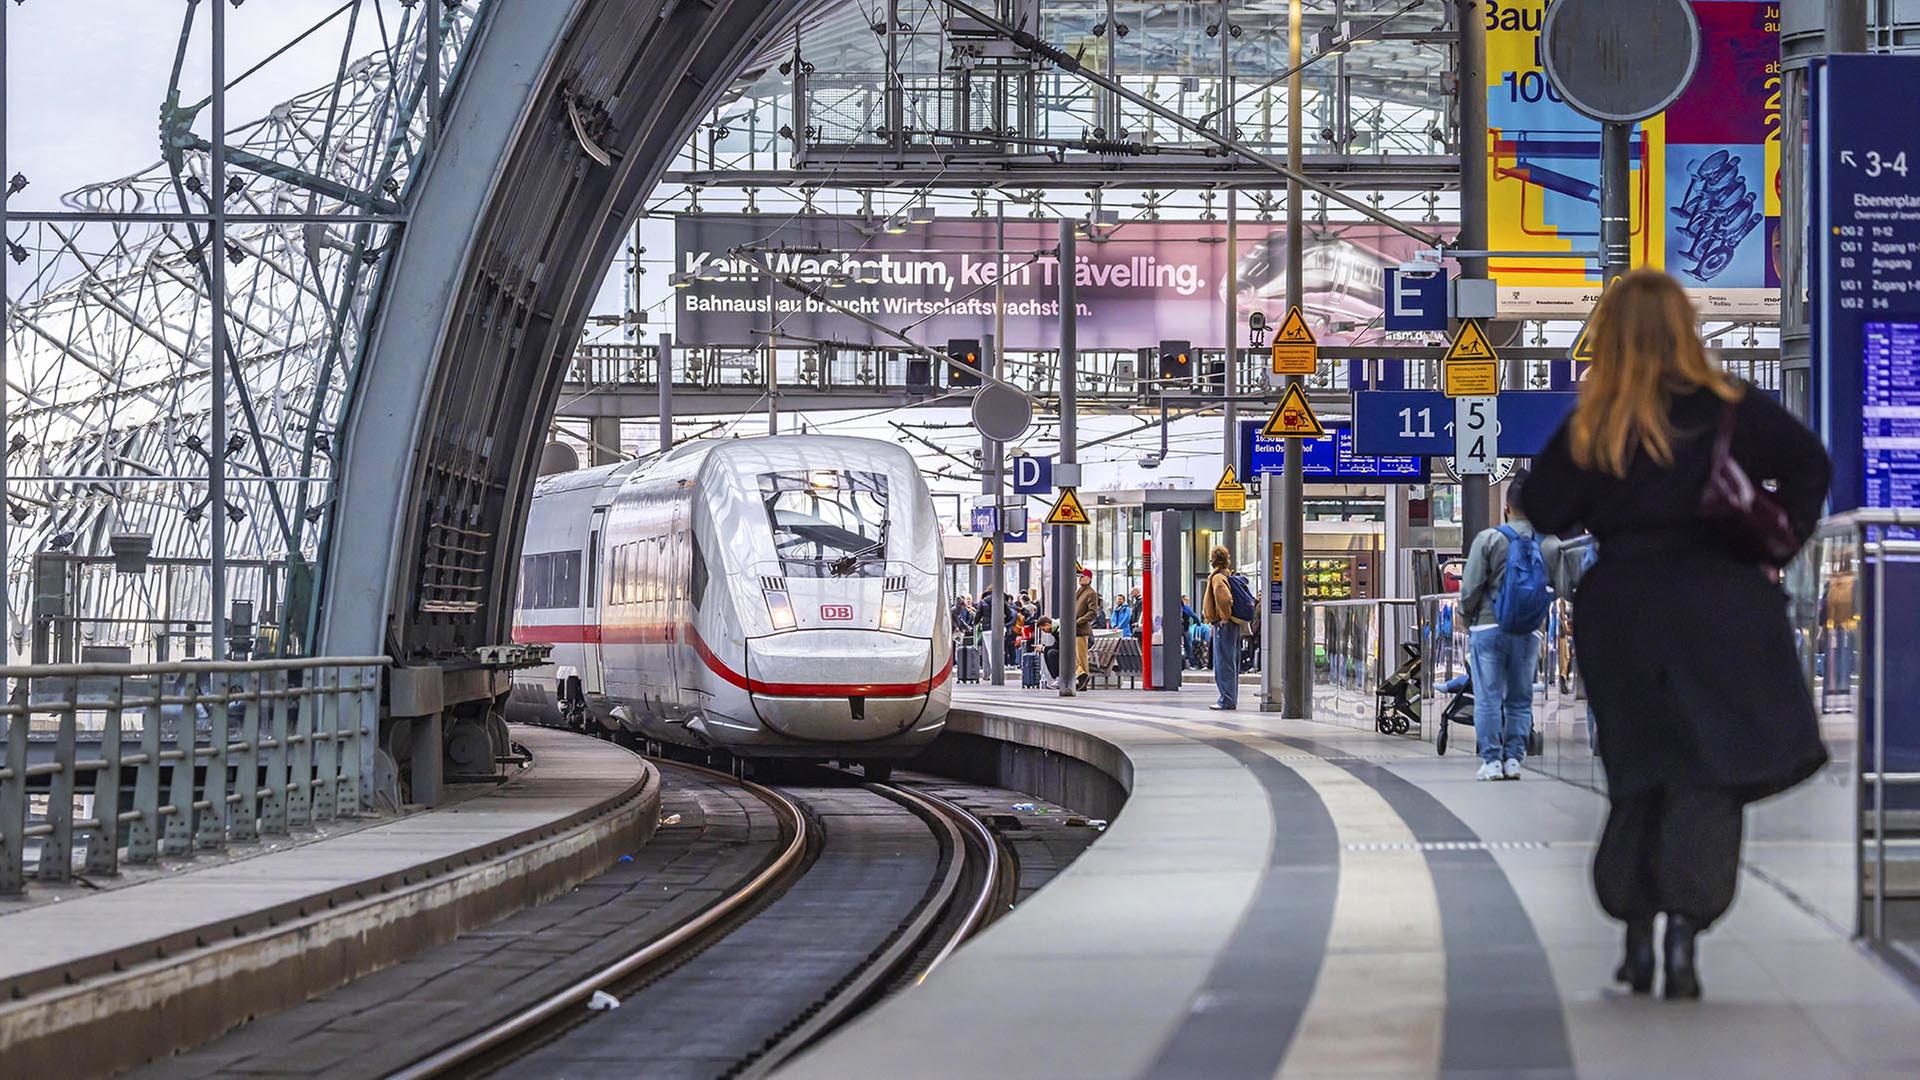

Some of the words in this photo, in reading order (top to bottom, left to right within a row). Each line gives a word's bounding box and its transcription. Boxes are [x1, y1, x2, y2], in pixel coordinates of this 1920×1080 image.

[1486, 0, 1550, 31] Bau
[1865, 151, 1909, 177] 3-4
[1872, 241, 1906, 254] Zugang
[686, 252, 759, 282] Kein
[961, 255, 1030, 285] kein
[1036, 255, 1205, 295] Tävelling.
[1872, 257, 1912, 270] Ausgang
[1394, 271, 1424, 316] E
[1872, 280, 1907, 293] Zugang
[686, 295, 801, 313] Bahnausbau
[806, 295, 879, 313] braucht
[883, 296, 1092, 316] Wirtschaftswachstm.
[1399, 407, 1435, 437] 11
[1467, 402, 1485, 430] 5
[1255, 444, 1275, 452] Berlin
[1468, 435, 1487, 462] 4
[1019, 458, 1040, 486] D
[825, 607, 850, 618] DB
